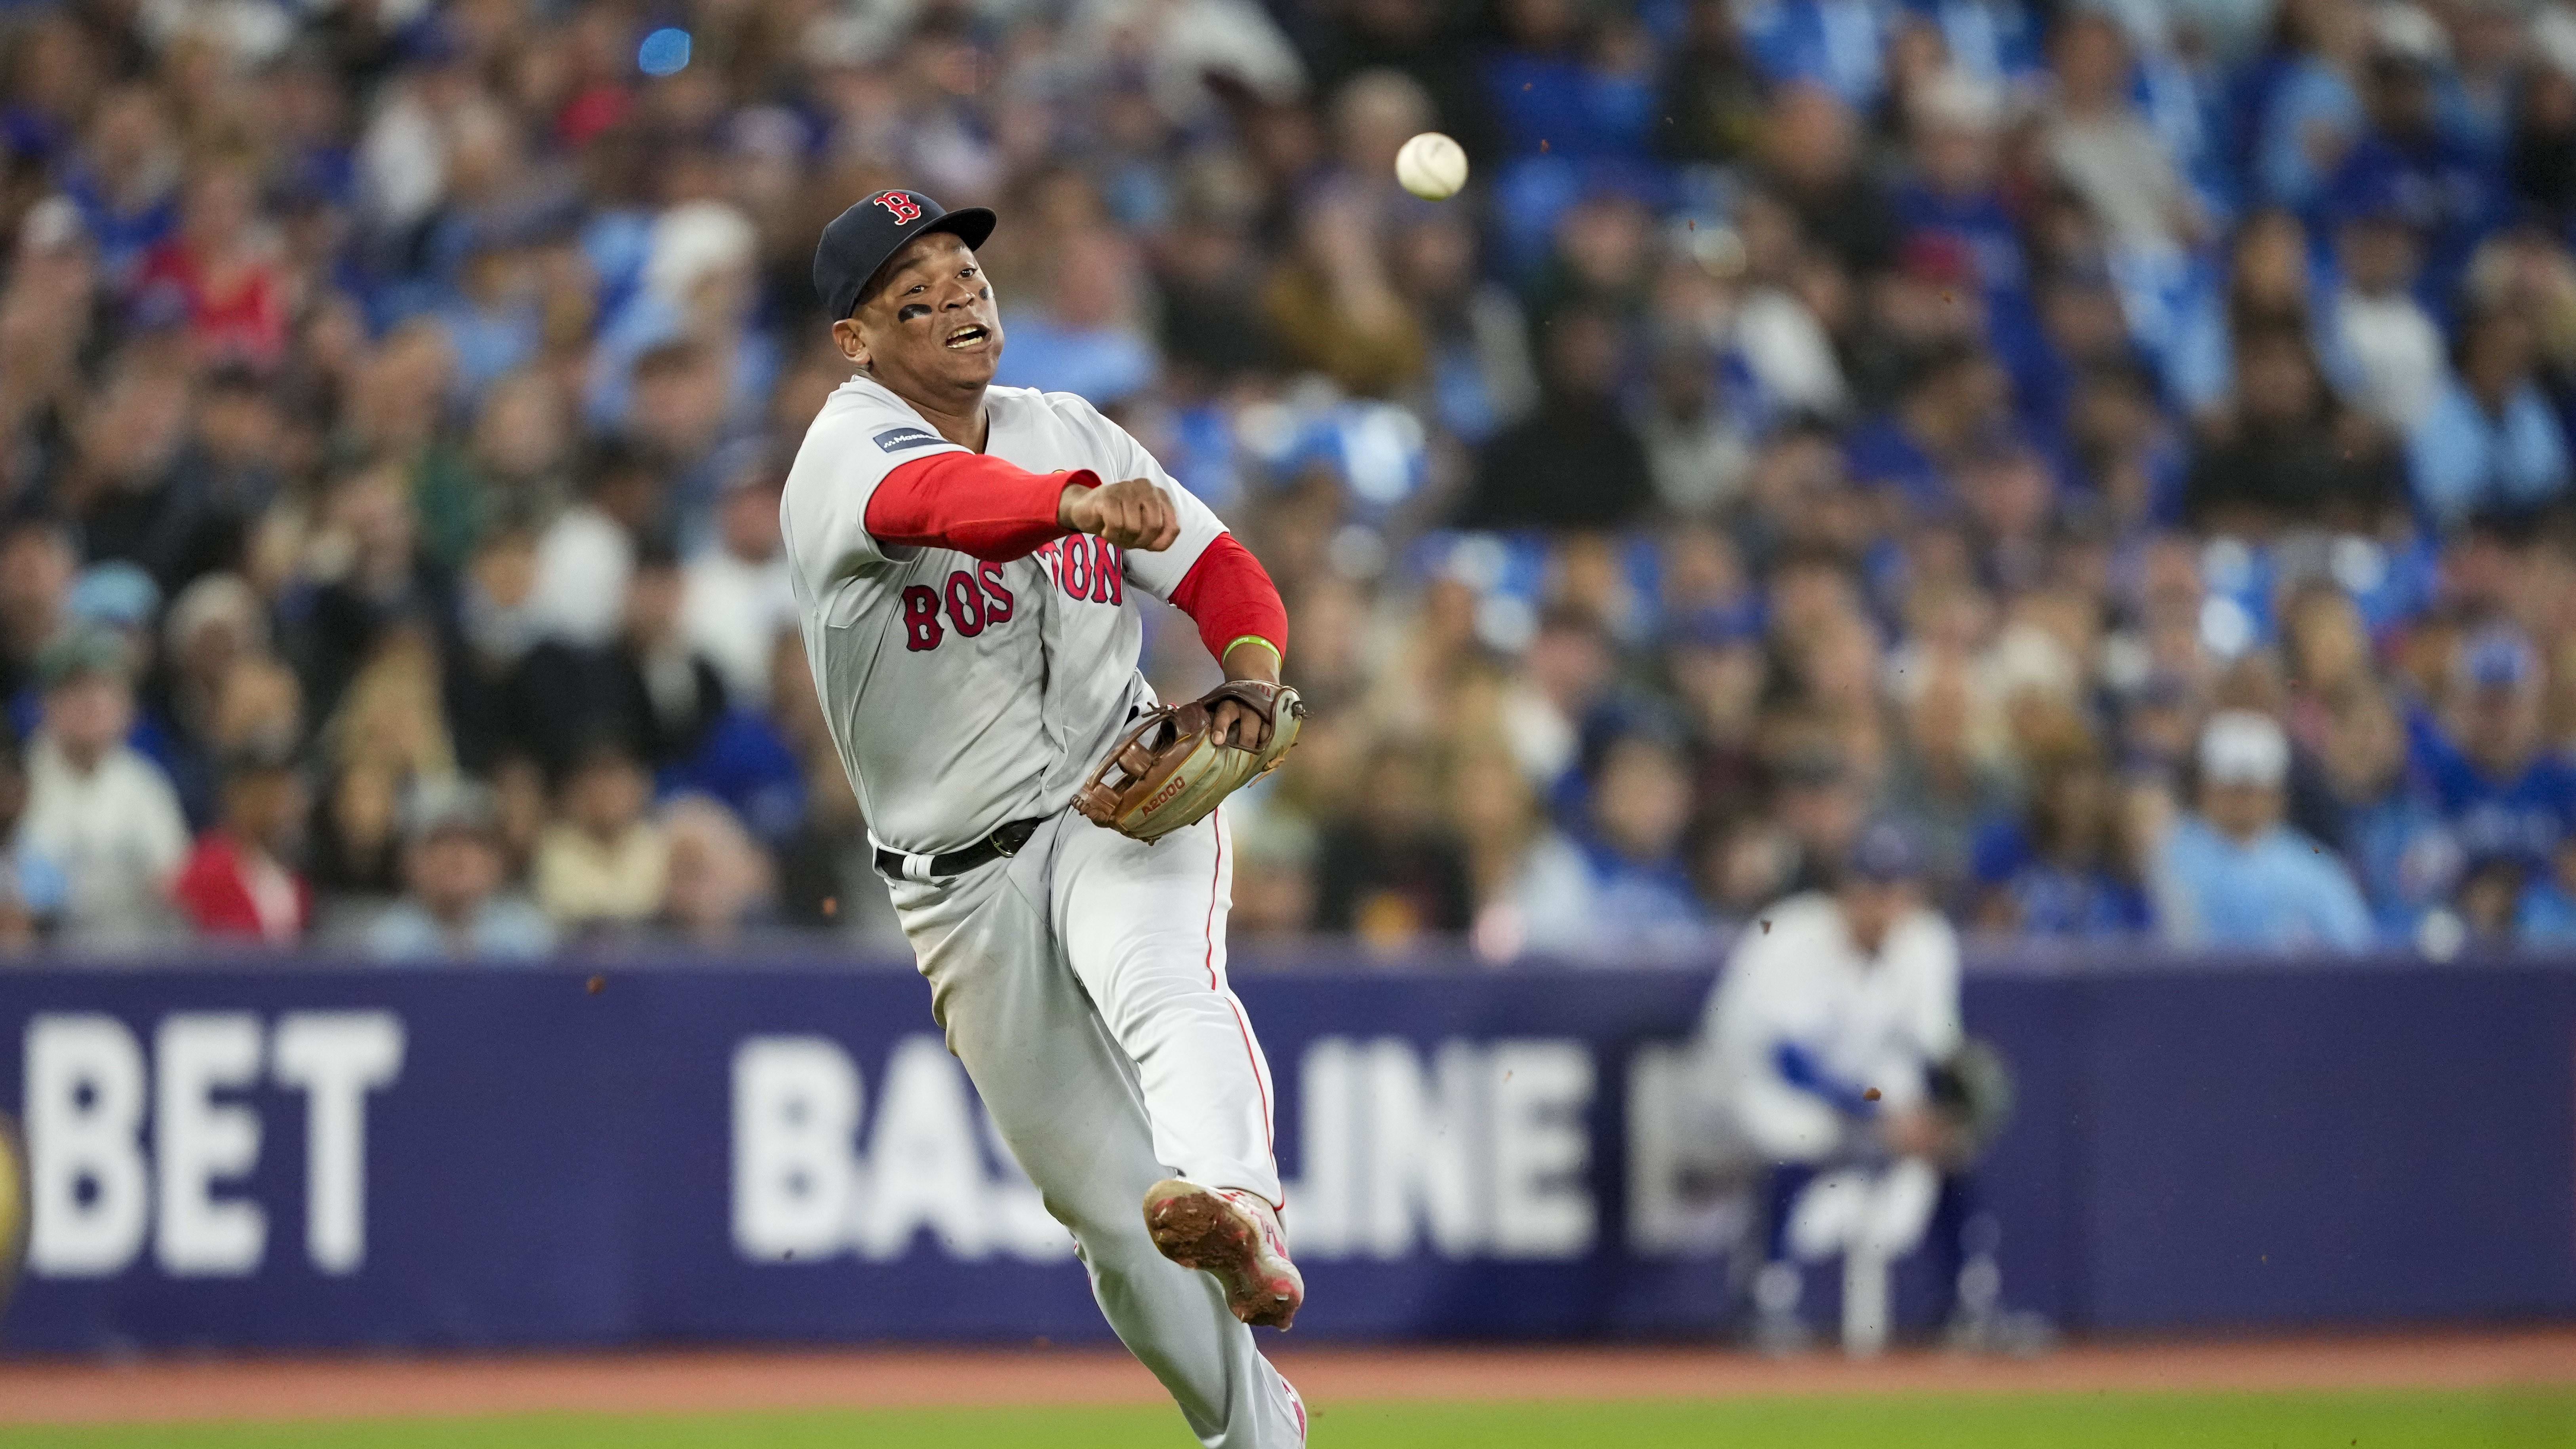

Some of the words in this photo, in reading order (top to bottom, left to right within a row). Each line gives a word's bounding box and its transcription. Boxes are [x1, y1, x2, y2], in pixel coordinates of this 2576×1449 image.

[873, 192, 921, 225] B
[901, 532, 1123, 652] BOSTON
[1142, 776, 1185, 818] A2000
[23, 1011, 406, 1276] BET
